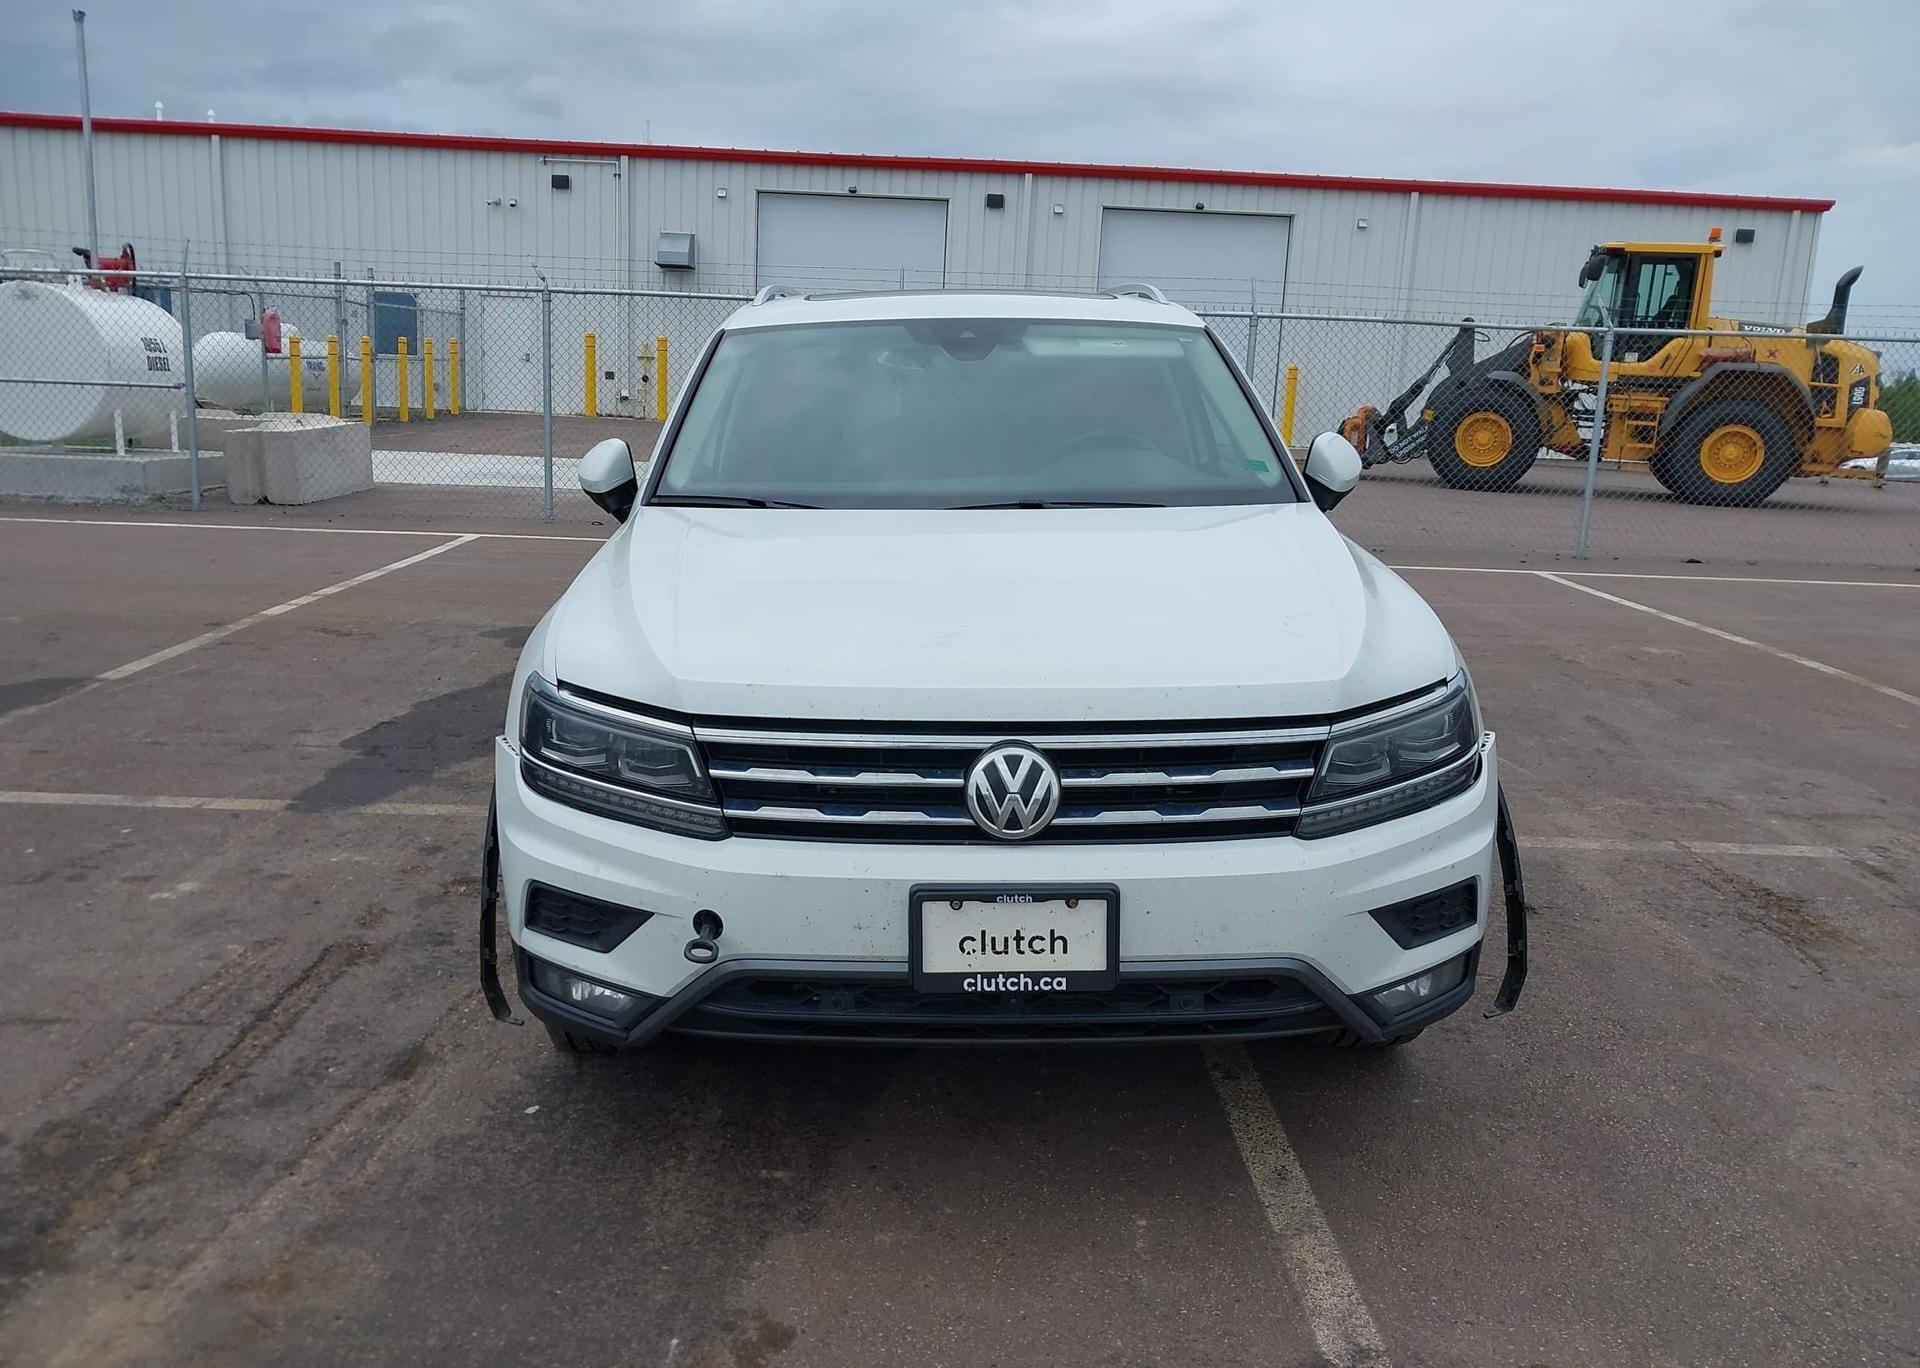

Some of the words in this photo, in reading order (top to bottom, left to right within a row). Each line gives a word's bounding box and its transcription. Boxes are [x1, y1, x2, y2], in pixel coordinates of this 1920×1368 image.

[1743, 324, 1786, 333] VOLVO
[147, 355, 171, 371] DIESEL
[996, 894, 1033, 904] clutch
[958, 929, 1069, 955] clutch
[963, 974, 1067, 992] clutch.ca
